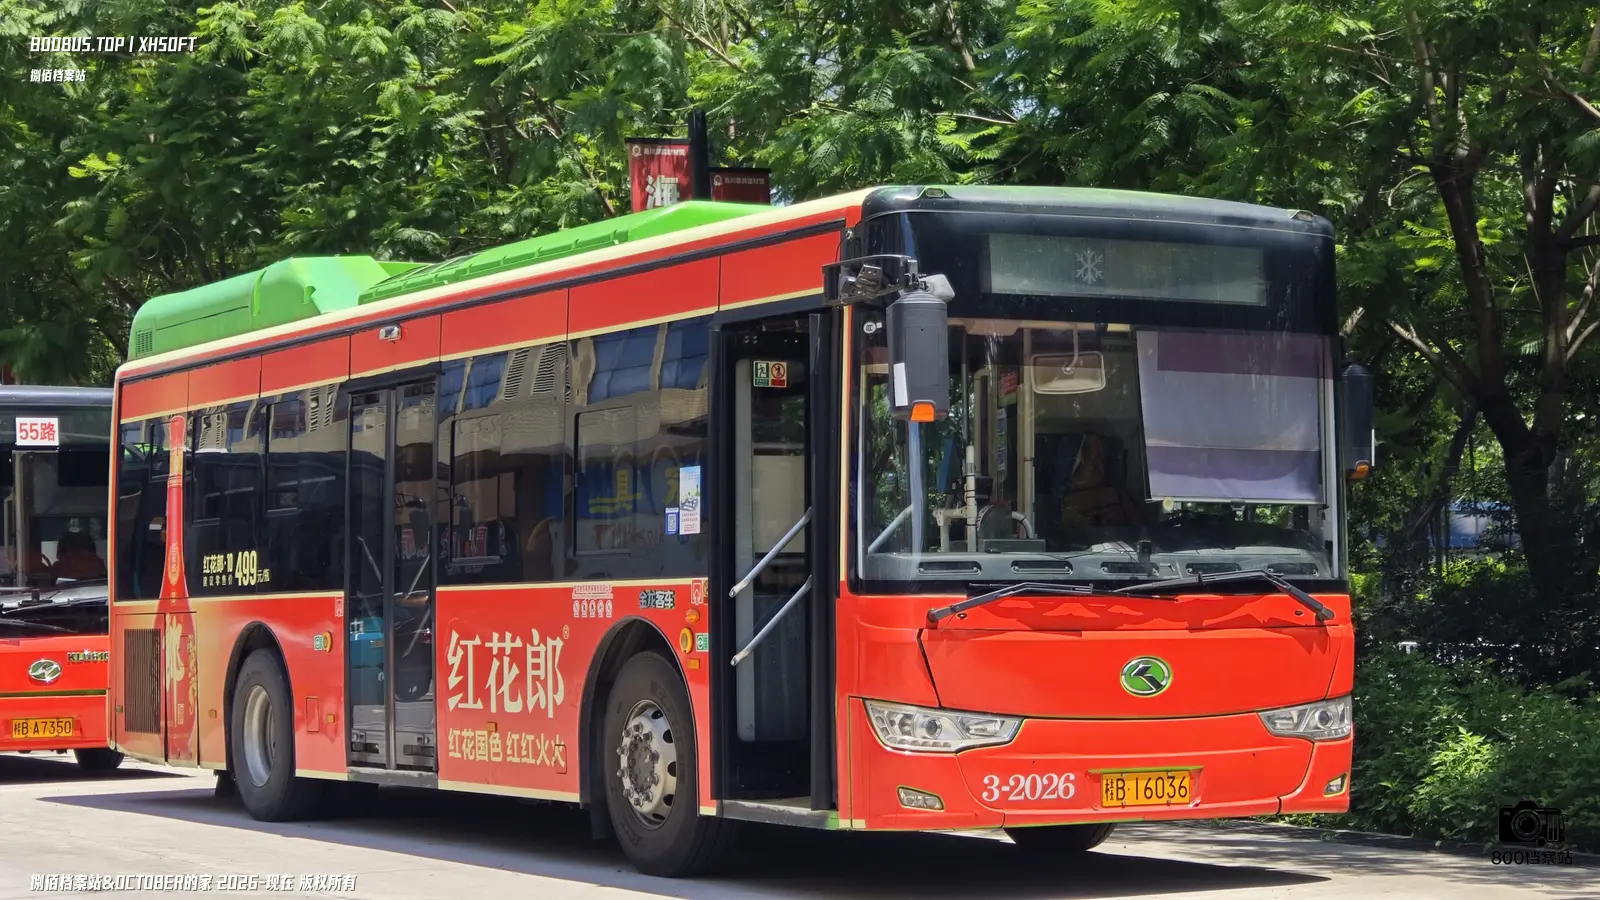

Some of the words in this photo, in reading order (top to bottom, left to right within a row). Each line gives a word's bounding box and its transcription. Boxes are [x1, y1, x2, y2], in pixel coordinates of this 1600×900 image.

[19, 422, 56, 441] 55路
[638, 589, 676, 609] 金龙客车
[447, 627, 565, 719] 红花郎
[448, 727, 503, 763] 红花国色
[505, 731, 566, 768] 红红火火
[981, 772, 1076, 802] 3-2026
